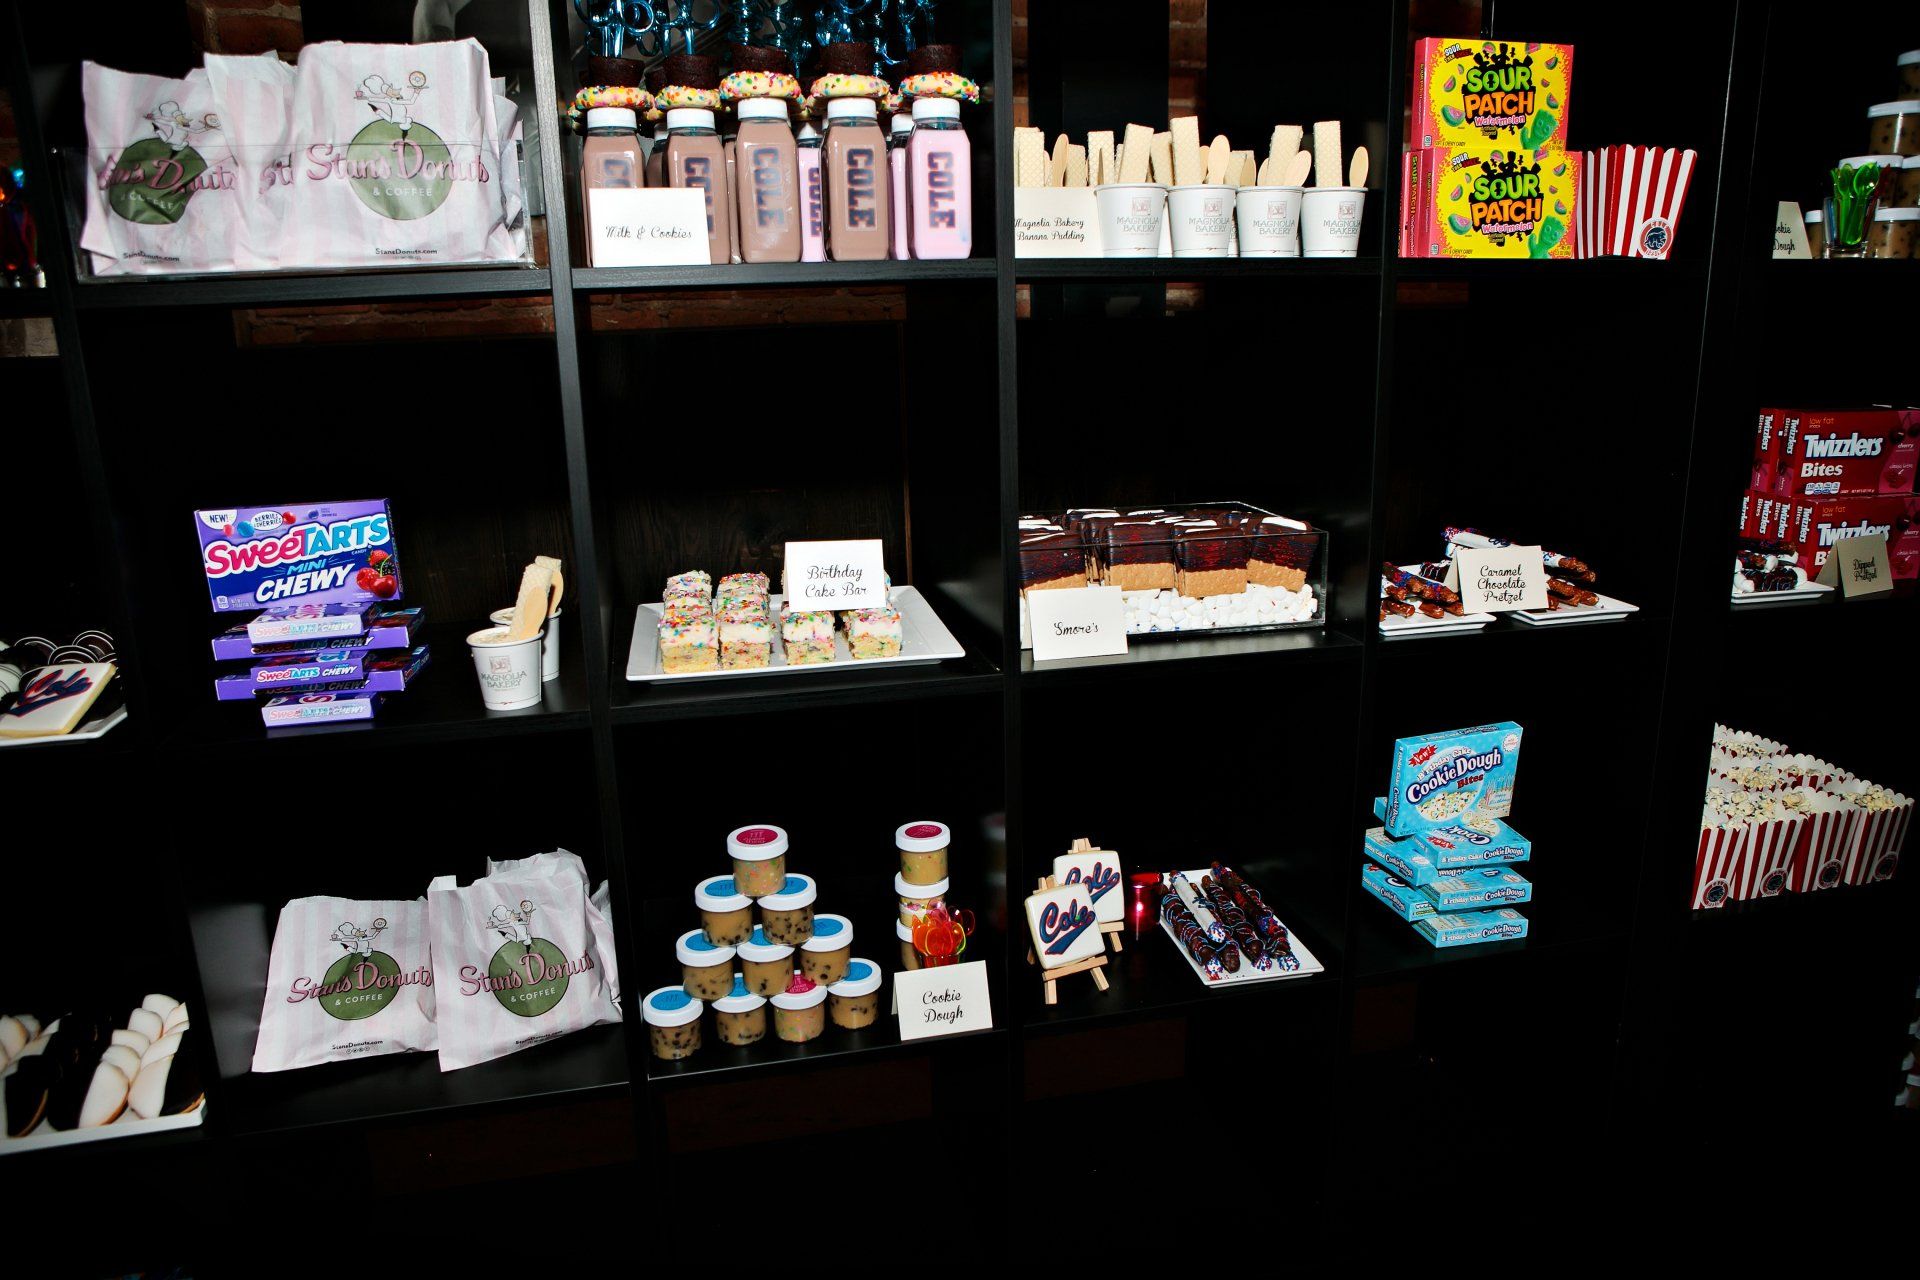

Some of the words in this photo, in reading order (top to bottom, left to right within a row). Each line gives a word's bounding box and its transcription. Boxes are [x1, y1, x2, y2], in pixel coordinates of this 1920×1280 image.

[1444, 43, 1461, 56] SOUR
[1467, 66, 1531, 93] SOUR
[1464, 91, 1534, 119] PATCH
[1474, 115, 1526, 126] Watermelon
[306, 143, 391, 181] Stan's
[392, 138, 489, 183] Donuts
[1452, 153, 1468, 165] SOUR
[372, 188, 380, 197] &
[386, 187, 433, 197] COFFEE
[754, 148, 785, 227] COLE
[847, 148, 876, 228] COLE
[928, 151, 956, 229] COLE
[1474, 173, 1539, 200] SOUR
[1116, 216, 1160, 225] MAGNOLIA
[1471, 198, 1542, 227] PATCH
[1014, 217, 1050, 230] Magnolia
[1053, 216, 1084, 229] Bakery
[1122, 224, 1157, 233] BAKERY
[1188, 217, 1230, 225] MAGNOLIA
[1195, 225, 1227, 233] BAKERY
[1482, 222, 1533, 233] Watermelon
[605, 225, 631, 239] Milk
[637, 225, 646, 241] &
[650, 225, 692, 239] Cookies
[1017, 231, 1048, 241] Banana
[1051, 230, 1085, 242] Pudding
[1259, 227, 1291, 235] BAKERY
[1329, 227, 1359, 235] BAKERY
[1823, 417, 1834, 425] fat
[1762, 415, 1774, 451] Twizzlers
[1786, 418, 1799, 455] Twizzlers
[1804, 432, 1884, 458] Twizzlers
[1801, 462, 1843, 478] Bites
[209, 514, 229, 524] NEW!
[254, 513, 279, 522] BERRIES
[1760, 500, 1773, 535] Twizzlers
[1778, 504, 1791, 538] Twizzlers
[1799, 507, 1812, 543] Twizzlers
[206, 516, 388, 575] SweeTARTS
[287, 559, 327, 575] MINI
[1479, 564, 1522, 578] Caramel
[1853, 556, 1875, 572] Dipped
[807, 563, 863, 582] Birthday
[1854, 568, 1877, 582] Pretzel
[255, 563, 356, 601] CHEWY
[805, 583, 836, 598] Cake
[842, 581, 867, 596] Bar
[1477, 576, 1526, 590] Chocolate
[1482, 590, 1524, 604] Pretzel
[321, 621, 354, 632] CHEWY
[330, 636, 374, 649] CHEWY
[257, 667, 320, 682] SweeTARTS
[322, 665, 357, 677] CHEWY
[481, 670, 527, 682] MAGNOLIA
[487, 679, 522, 689] BAKERY
[332, 704, 366, 717] CHEWY
[1413, 745, 1431, 762] New!
[1456, 774, 1484, 789] Bites
[1039, 899, 1095, 950] Cole
[287, 975, 352, 1003] Stan's
[353, 962, 433, 991] Donuts
[459, 964, 523, 996] Stan's
[335, 998, 341, 1006] &
[345, 993, 383, 1004] COFFEE
[519, 987, 556, 1001] COFFEE
[922, 989, 962, 1005] Cookie
[924, 1006, 963, 1024] Dough
